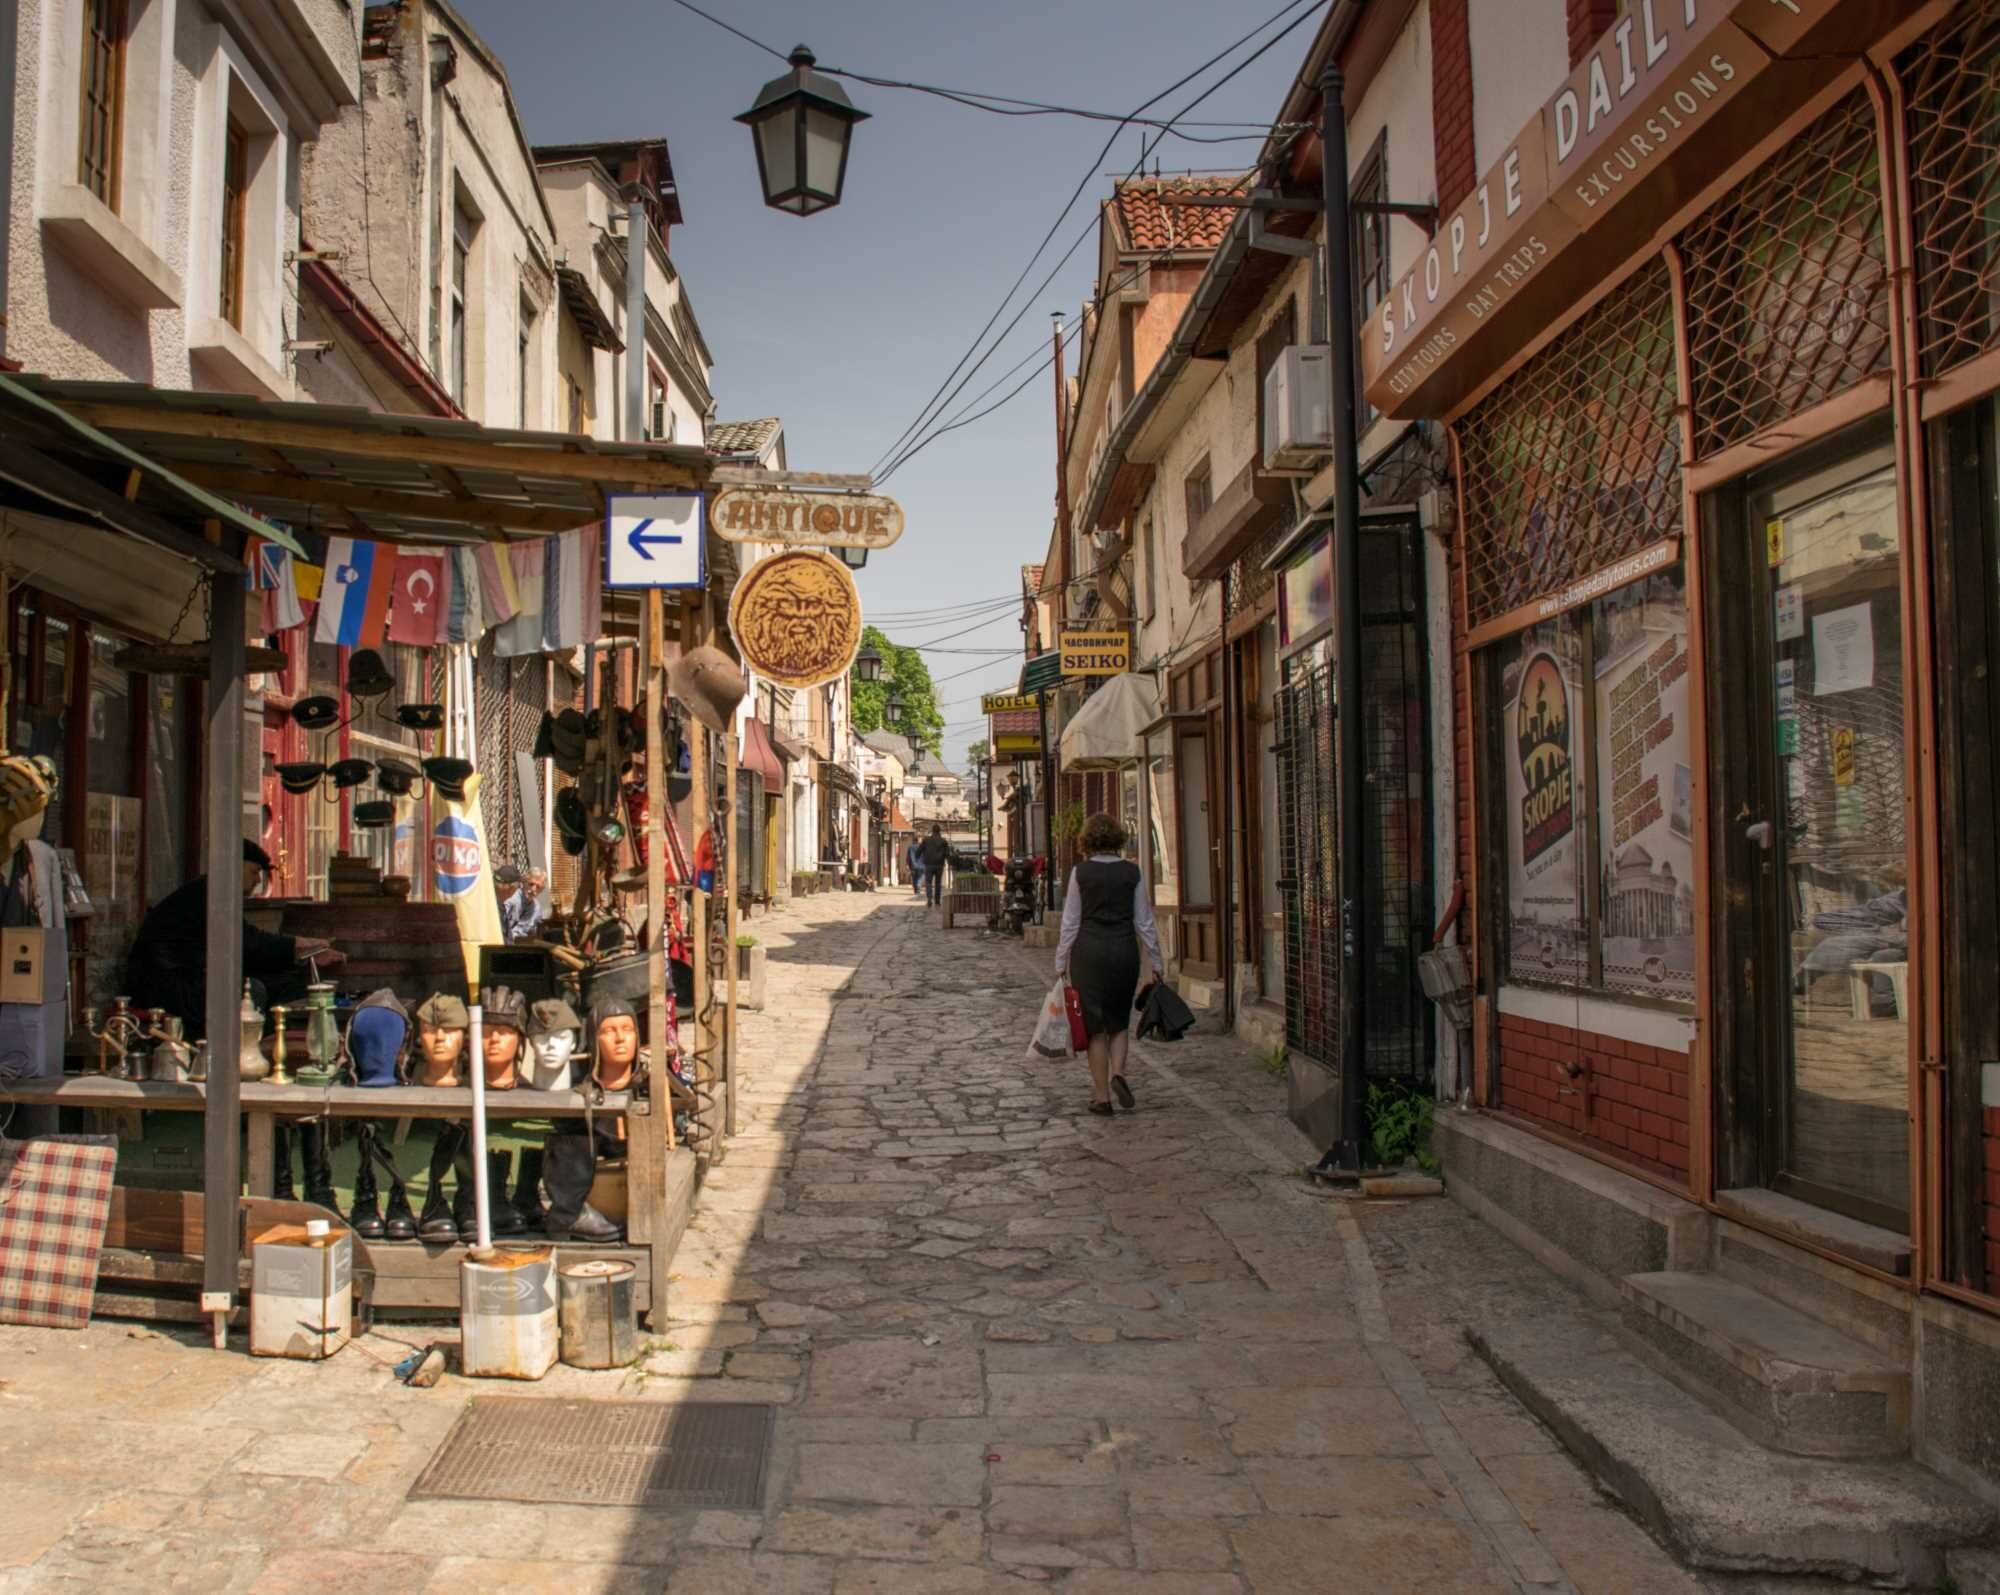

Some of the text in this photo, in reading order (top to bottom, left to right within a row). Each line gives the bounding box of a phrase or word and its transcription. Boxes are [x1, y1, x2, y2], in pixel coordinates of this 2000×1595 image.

[1382, 147, 1522, 353] SKOPJE
[1389, 53, 1735, 394] CITY TOURS DAY TRIPS EXCURSIONS
[1064, 654, 1127, 669] SEIKO
[983, 694, 1031, 709] HOTEL
[1523, 767, 1570, 835] SKOPJE
